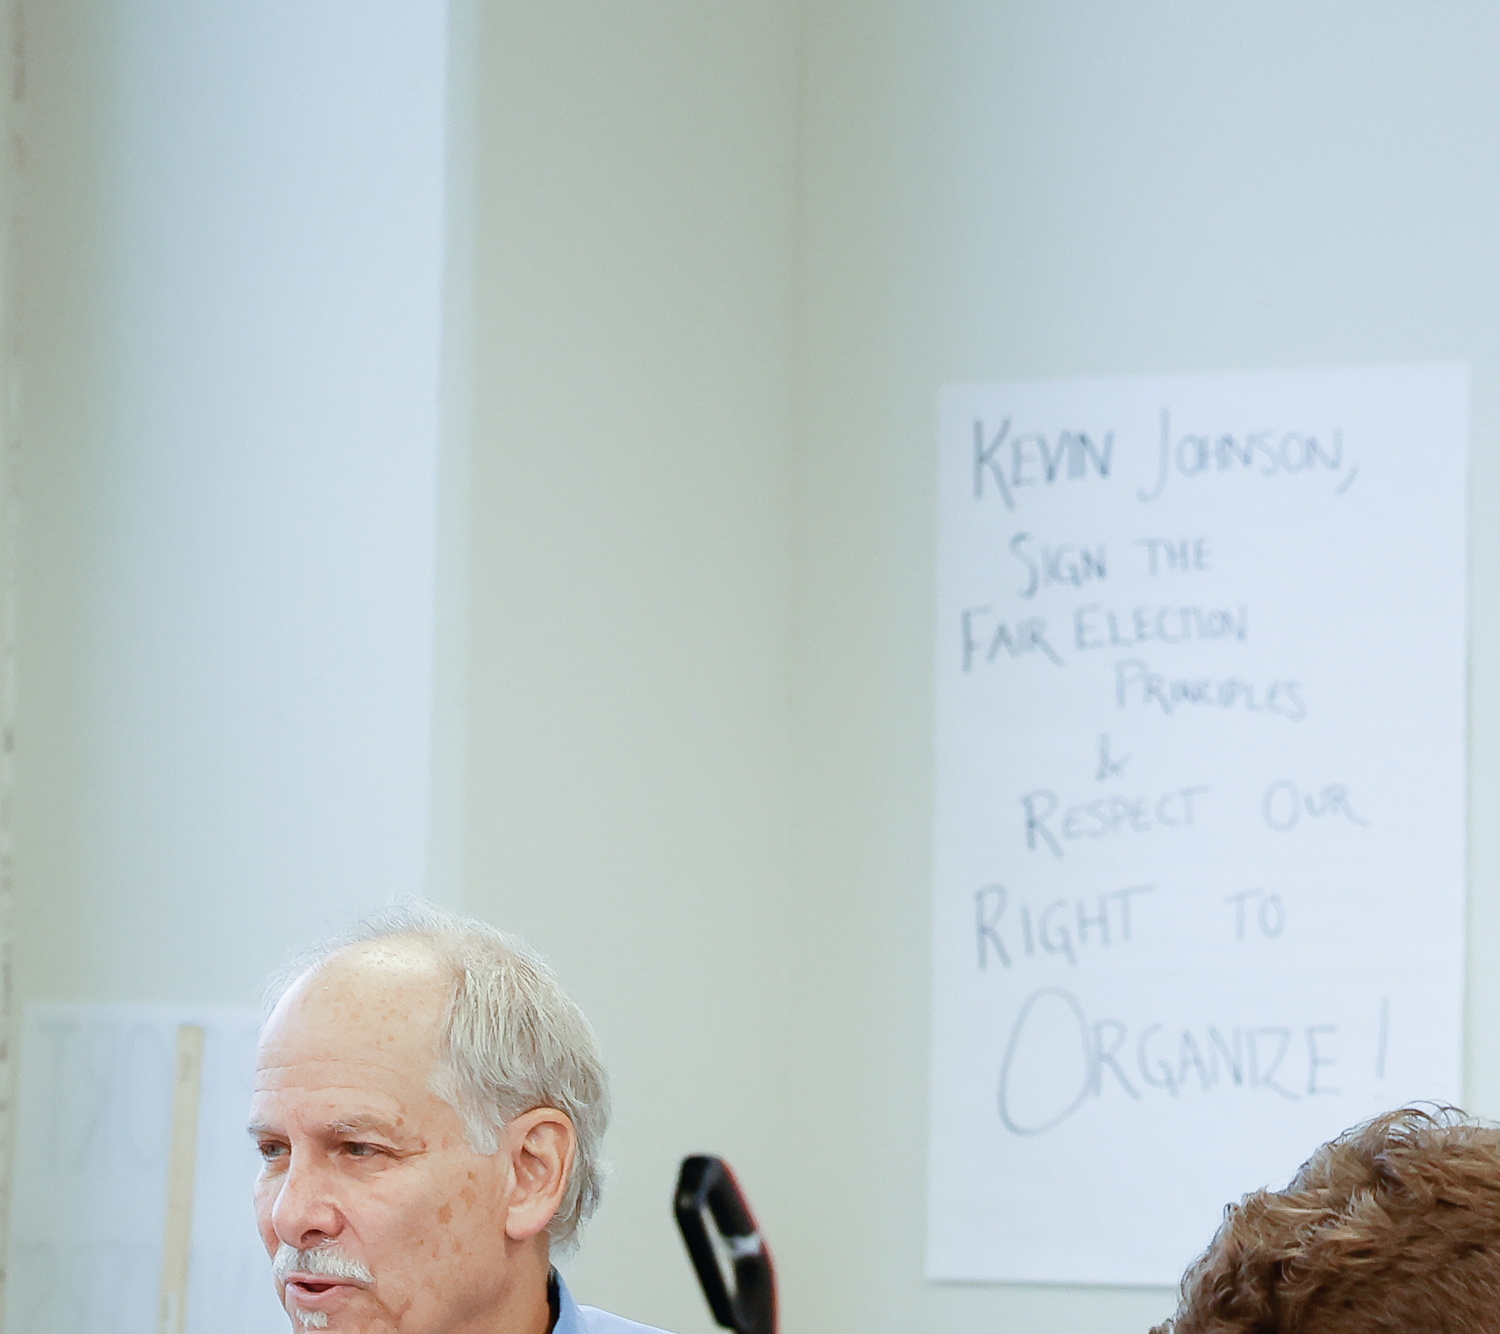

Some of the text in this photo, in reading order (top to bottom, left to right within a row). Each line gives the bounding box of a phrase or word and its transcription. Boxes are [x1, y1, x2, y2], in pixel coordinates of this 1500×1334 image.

[972, 415, 1116, 511] KEVIN
[1009, 530, 1211, 599] SIGN THE
[959, 604, 1248, 673] FAIR ELECTION
[1020, 779, 1370, 859] RESPECT OUR
[974, 883, 1287, 973] RIGHT TO
